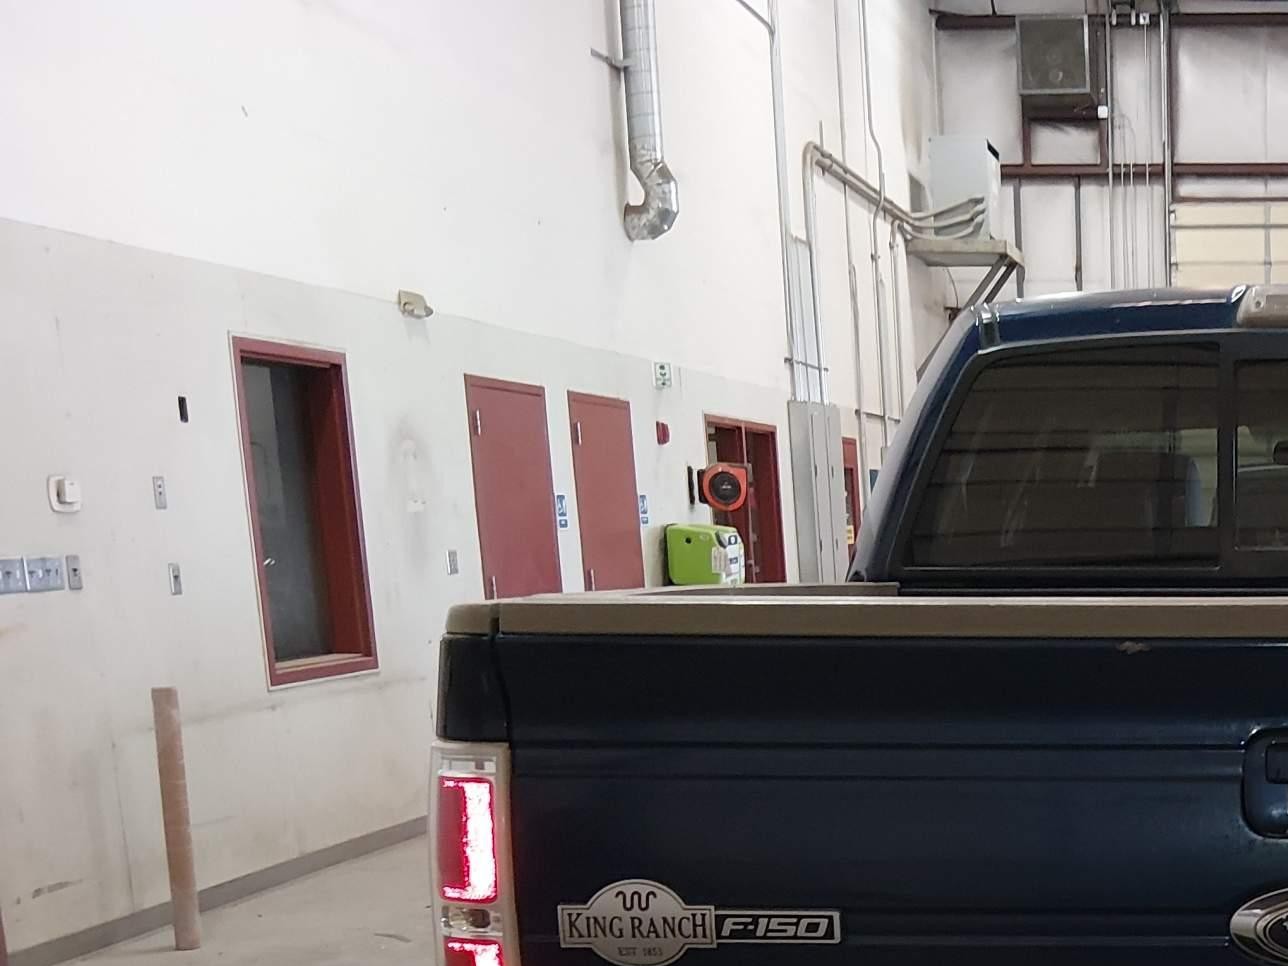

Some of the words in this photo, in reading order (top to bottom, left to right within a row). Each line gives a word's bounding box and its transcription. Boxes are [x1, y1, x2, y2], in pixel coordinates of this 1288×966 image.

[567, 912, 624, 939] KING
[631, 912, 707, 939] RANCH
[720, 917, 829, 937] F-150
